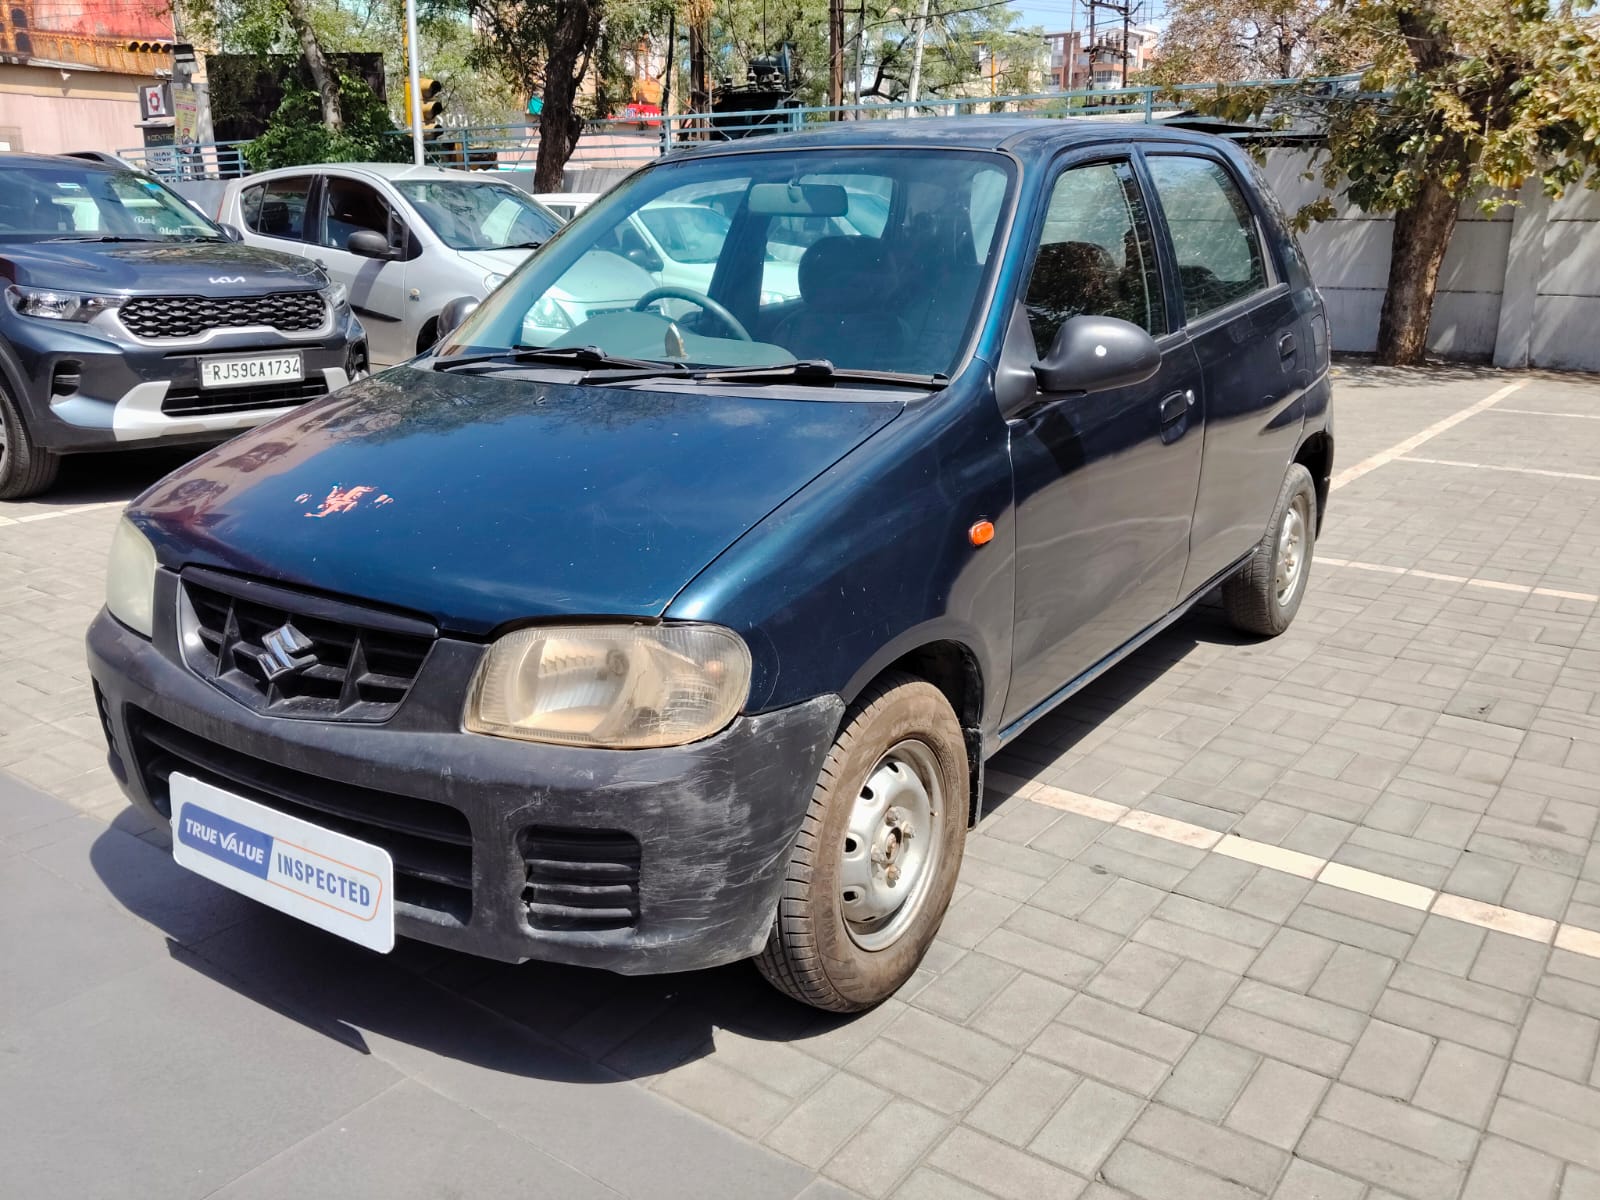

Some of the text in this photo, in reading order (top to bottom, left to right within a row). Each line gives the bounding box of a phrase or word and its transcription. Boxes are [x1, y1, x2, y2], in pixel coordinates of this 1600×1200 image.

[212, 358, 300, 381] RJ59CA1734
[185, 818, 264, 865] TRUE VALUE
[277, 852, 371, 908] INSPECTED
